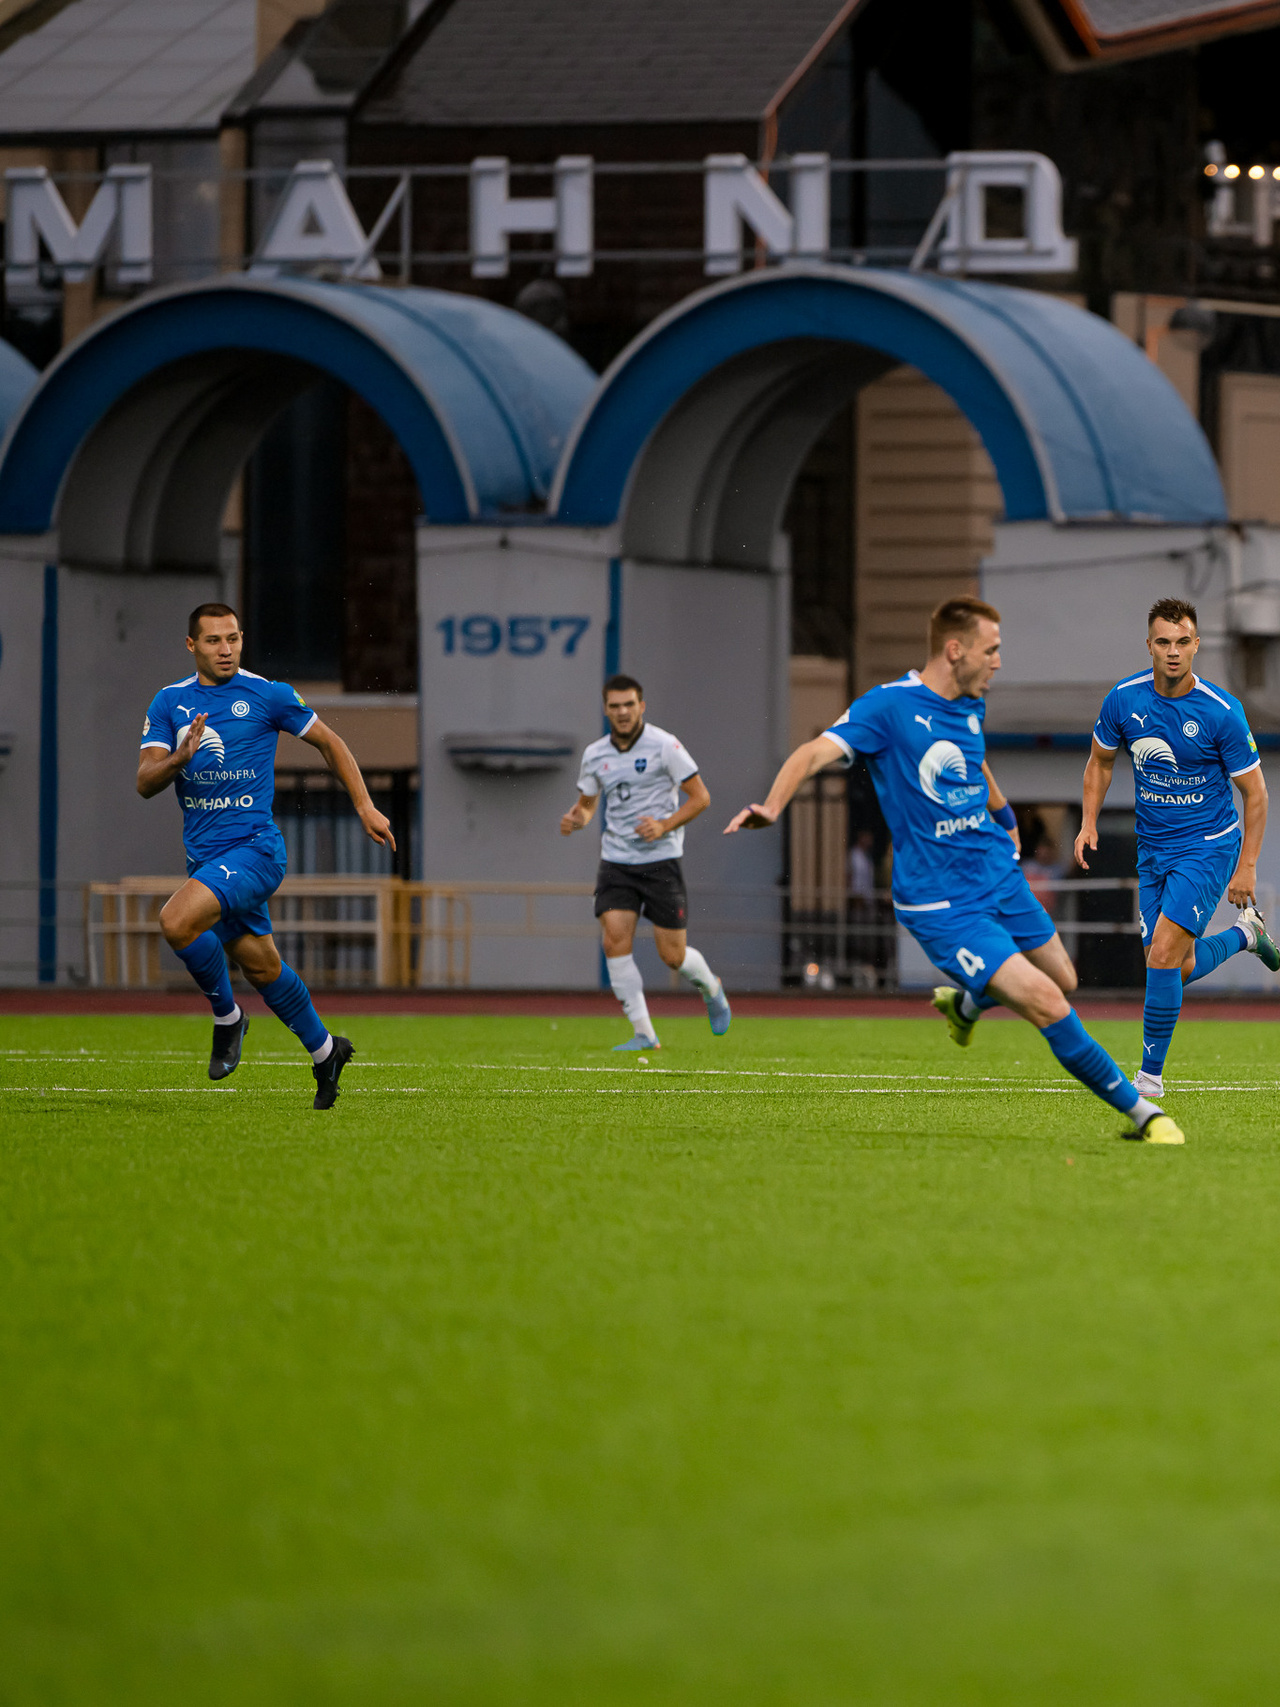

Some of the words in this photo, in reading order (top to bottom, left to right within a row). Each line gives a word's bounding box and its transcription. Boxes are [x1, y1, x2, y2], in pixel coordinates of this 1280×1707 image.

[437, 614, 591, 657] 1957
[184, 794, 254, 811] ДИНАМО
[956, 947, 986, 978] 4
